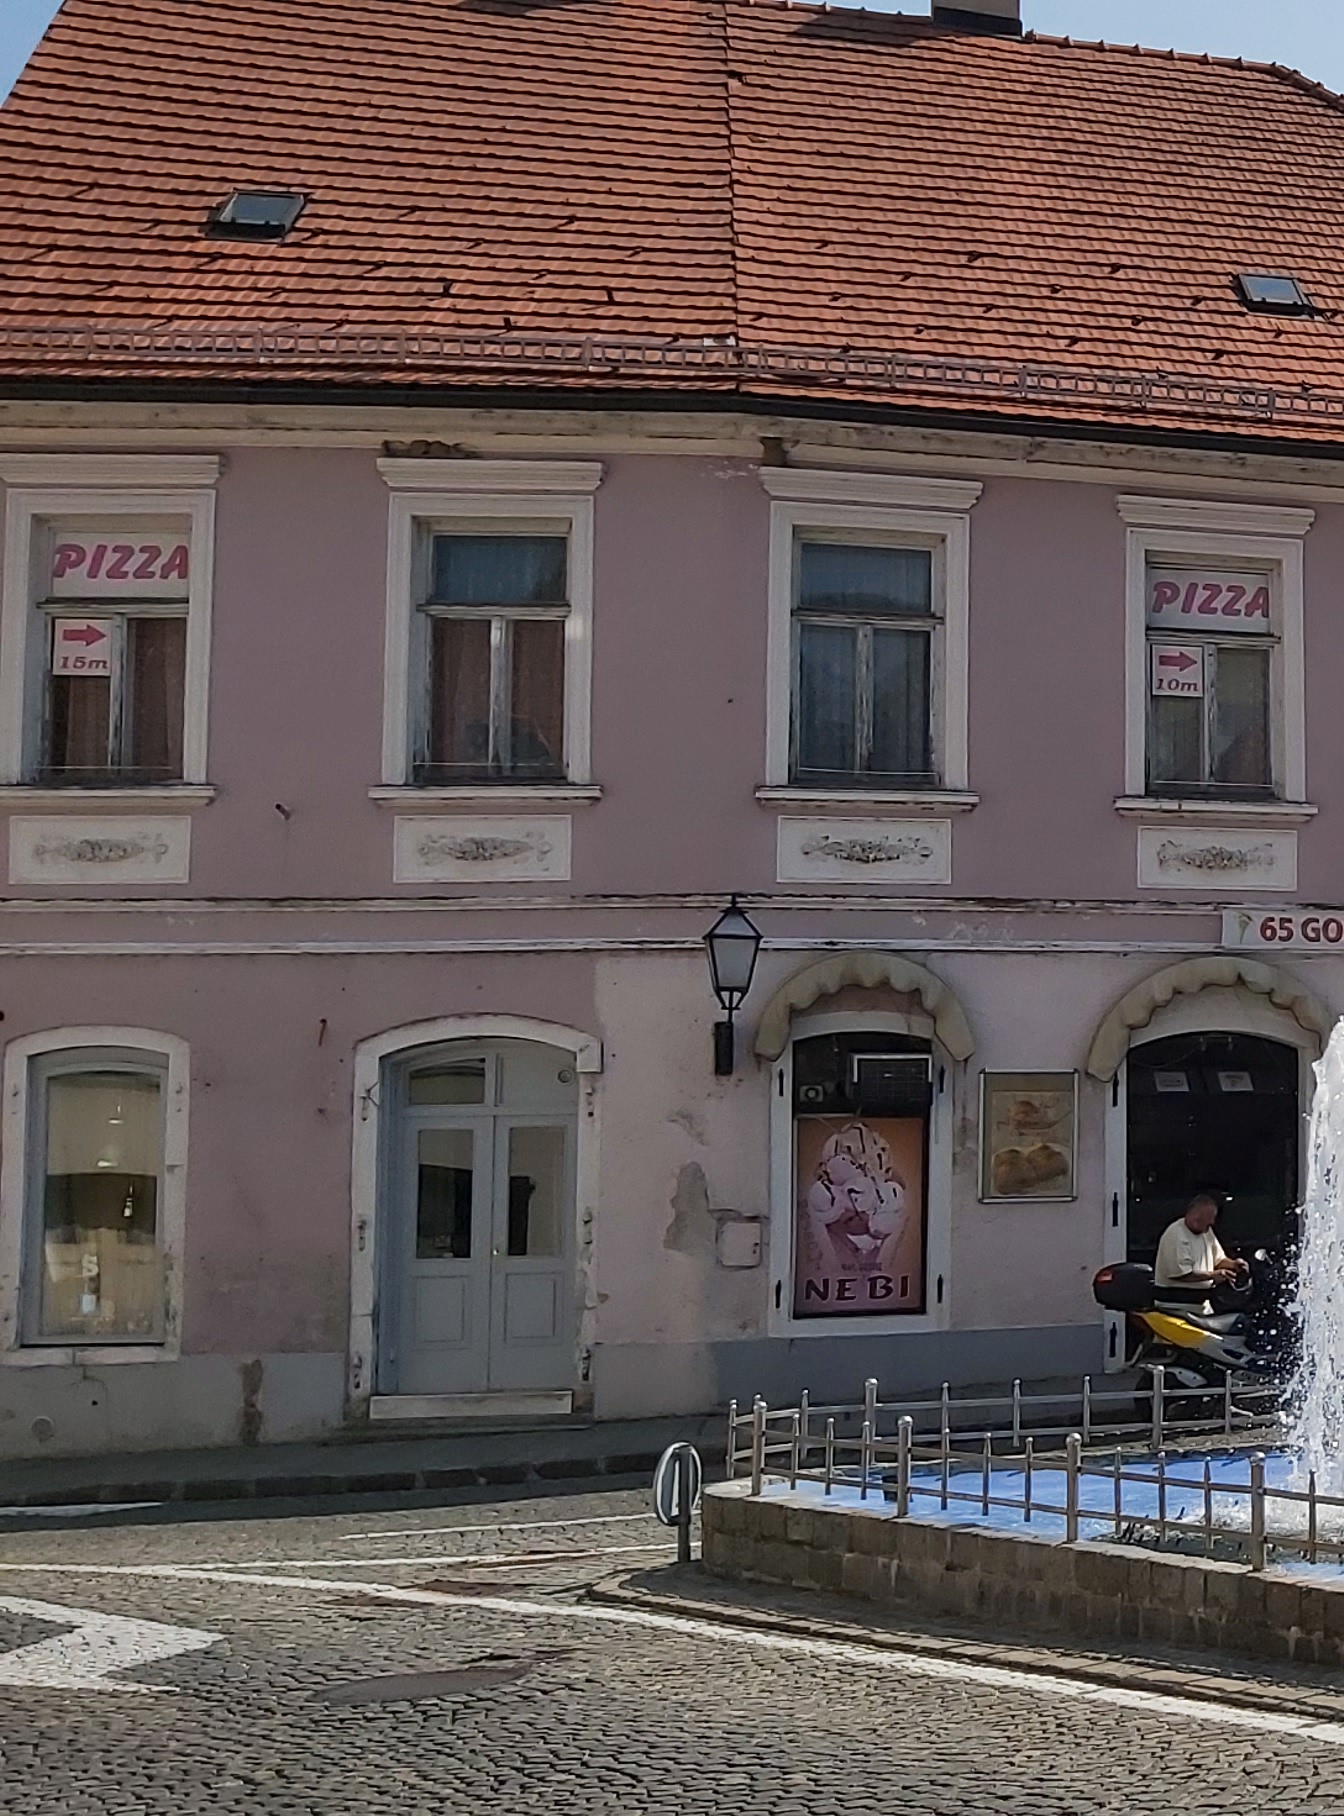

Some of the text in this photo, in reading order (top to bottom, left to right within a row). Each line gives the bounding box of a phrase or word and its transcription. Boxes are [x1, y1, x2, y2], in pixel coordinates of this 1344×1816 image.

[53, 544, 188, 579] PIZZA
[1152, 581, 1269, 618] PIZZA
[60, 656, 108, 669] 15m
[1156, 678, 1199, 692] 10m
[1260, 917, 1294, 942] 65
